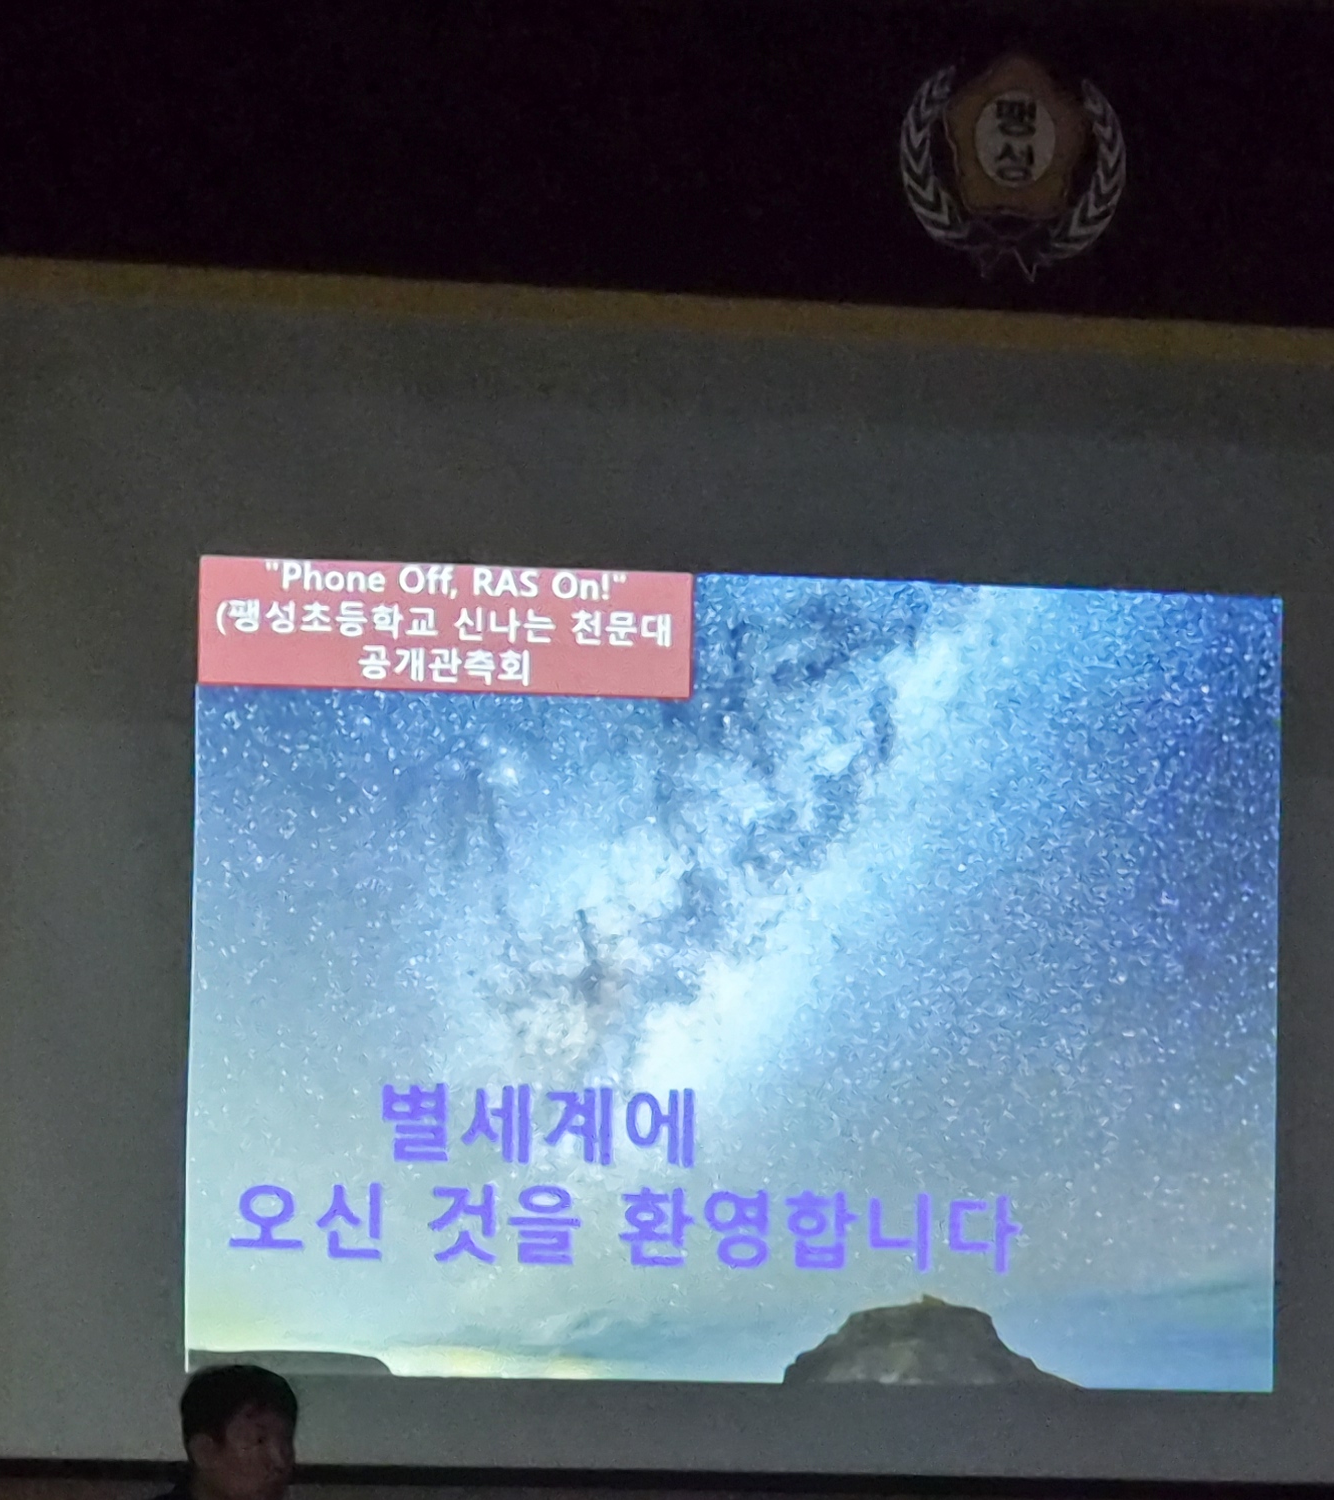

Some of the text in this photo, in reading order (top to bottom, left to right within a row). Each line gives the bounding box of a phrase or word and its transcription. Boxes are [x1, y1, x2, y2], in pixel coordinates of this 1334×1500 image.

[265, 560, 627, 601] "Phone Off, RAS On!"
[216, 598, 672, 648] (팽성초등학교 신나는 천문대
[358, 644, 531, 687] 공개관측회
[379, 1082, 697, 1168] 별세계에
[228, 1182, 1023, 1275] 오신 것을 환영합니다
